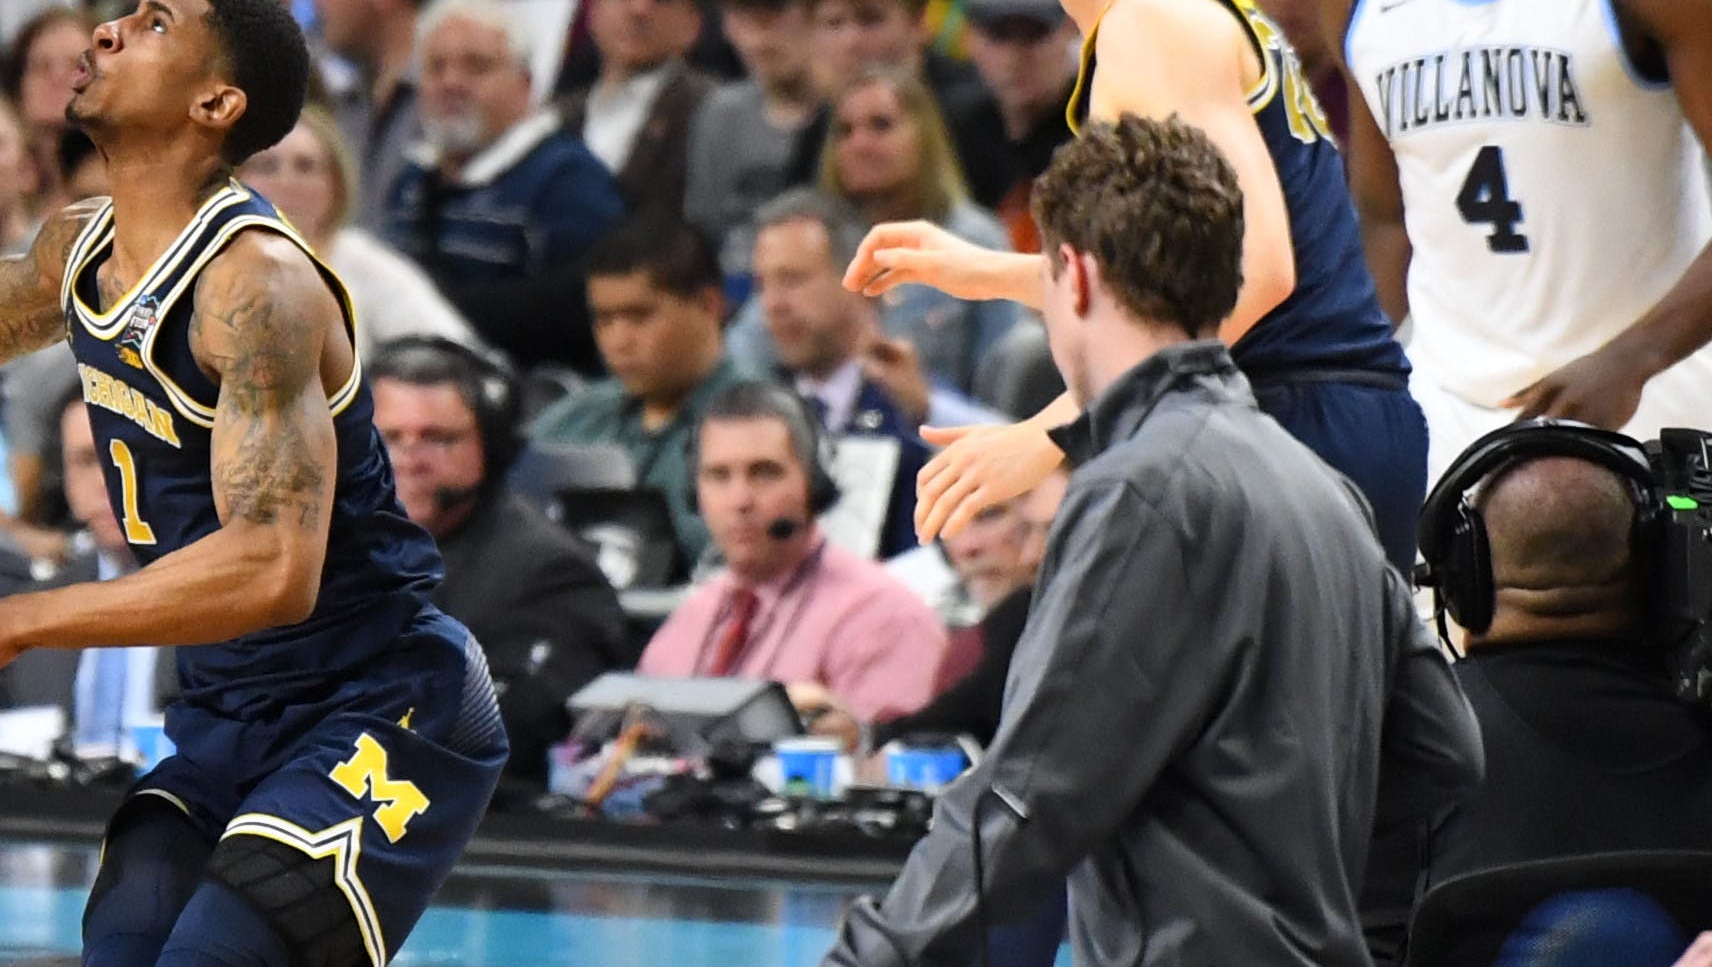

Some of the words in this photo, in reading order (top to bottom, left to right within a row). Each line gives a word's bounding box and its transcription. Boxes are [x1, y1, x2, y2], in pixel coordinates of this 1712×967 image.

[1374, 45, 1590, 141] VILLANOVA
[1455, 145, 1530, 252] 4
[77, 362, 182, 449] ICHIGAN
[110, 438, 157, 545] 1
[328, 731, 431, 844] M
